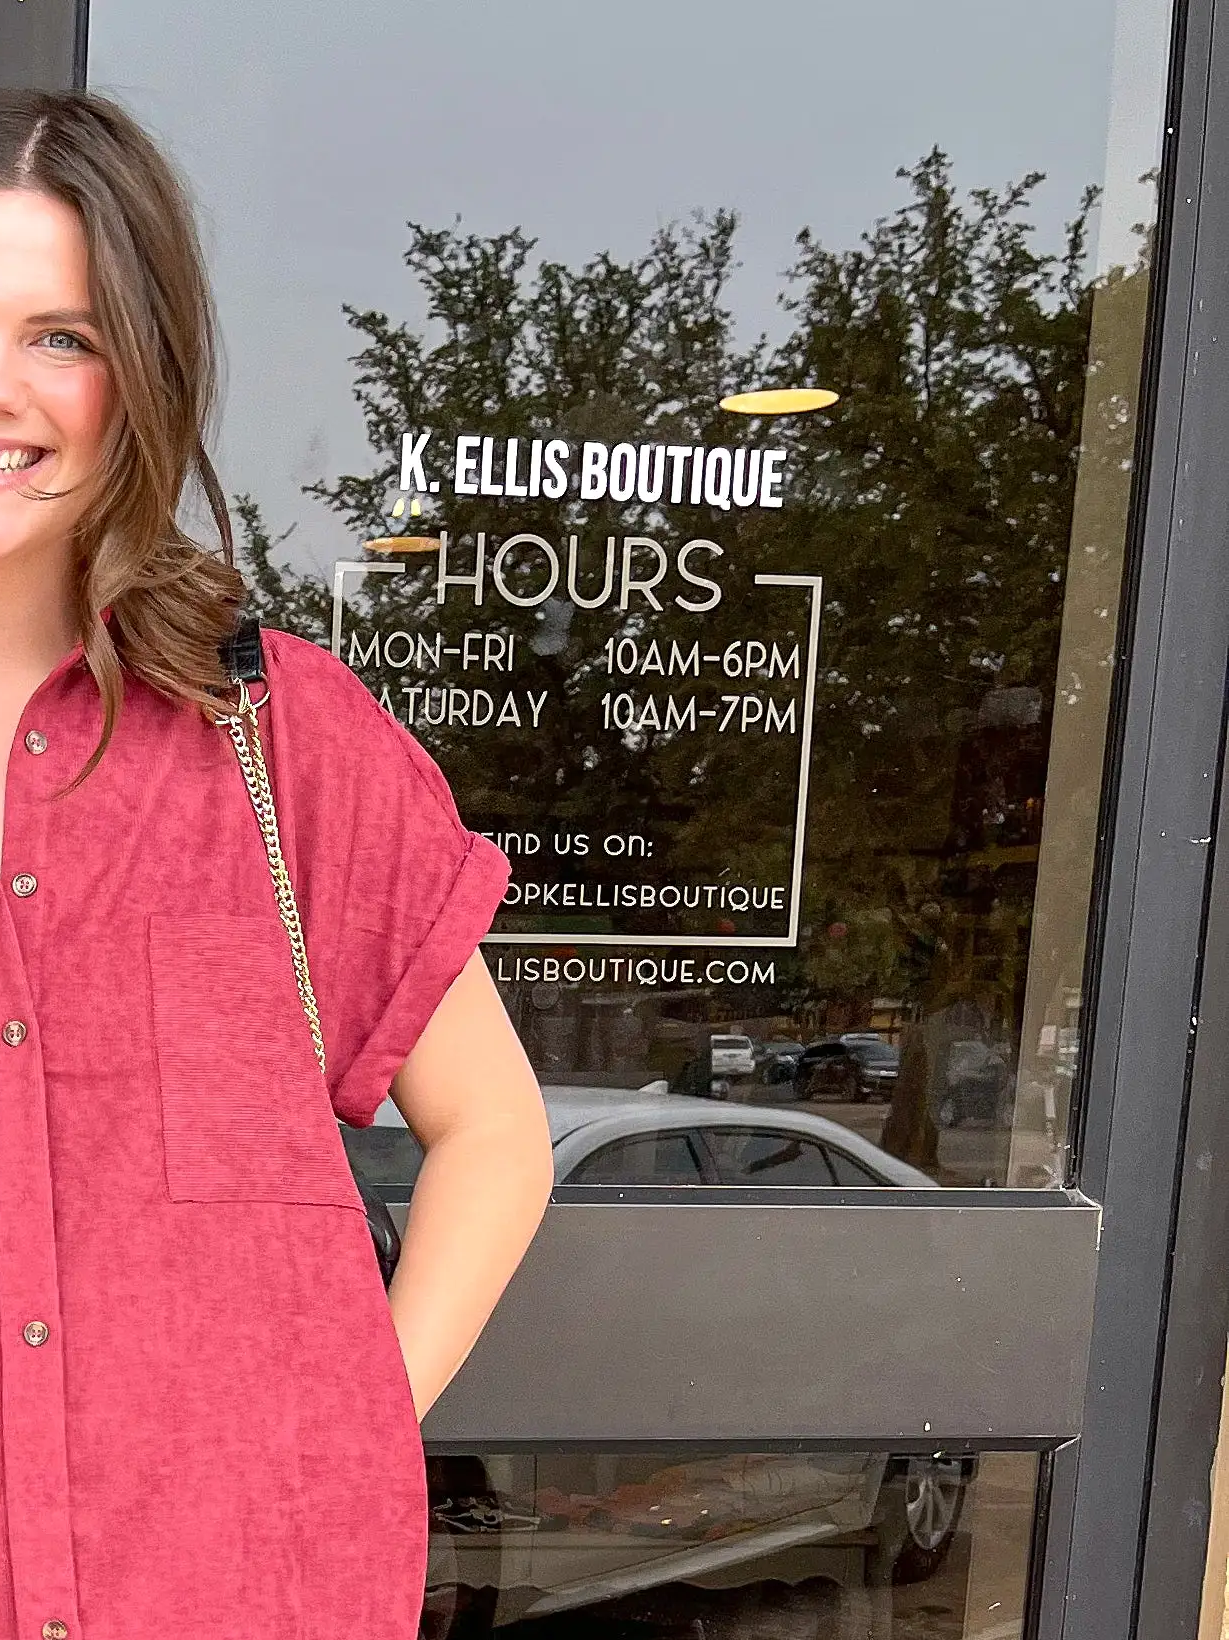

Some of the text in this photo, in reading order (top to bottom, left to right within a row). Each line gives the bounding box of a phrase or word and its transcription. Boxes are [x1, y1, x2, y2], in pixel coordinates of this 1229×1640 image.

[399, 433, 787, 511] K. ELLIS BOUTIQUE
[437, 530, 724, 612] HOURS
[348, 629, 800, 680] MON-FRI 10AM-6PM
[379, 687, 797, 734] ATURDAY 10AM-7PM
[554, 833, 590, 856] US
